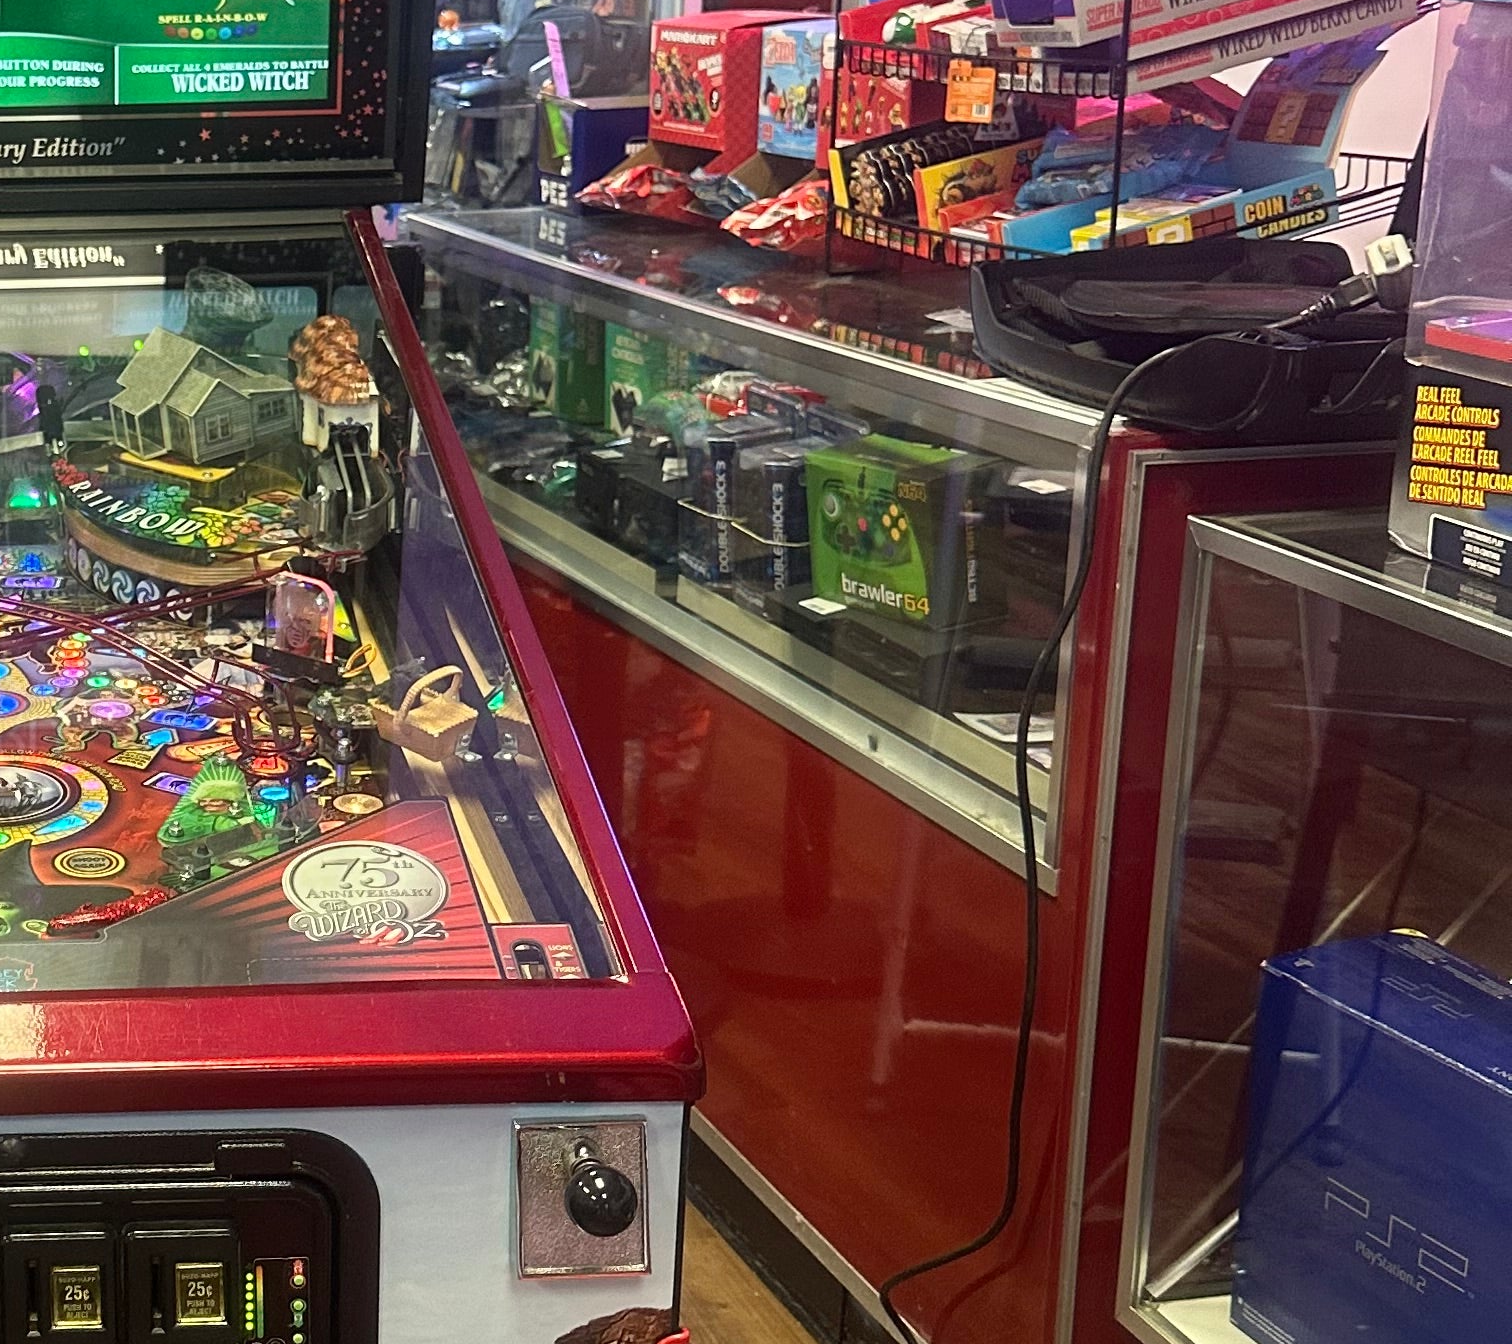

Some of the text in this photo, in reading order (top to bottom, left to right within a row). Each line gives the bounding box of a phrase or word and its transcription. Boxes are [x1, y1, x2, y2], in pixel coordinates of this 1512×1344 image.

[158, 14, 191, 25] SPELL
[52, 61, 104, 73] DURING
[132, 64, 180, 74] COLLECT
[272, 61, 288, 70] TO
[29, 76, 100, 88] PROGRESS
[171, 70, 310, 93] WICKED WITCH
[1245, 195, 1287, 224] COIN
[1416, 386, 1462, 404] REAL FEEL
[1415, 403, 1500, 427] ARCADE CONTROLS
[1413, 425, 1486, 447] COMMANDES DE
[1454, 447, 1476, 466] REEL
[1476, 450, 1500, 468] FEEL
[1410, 465, 1462, 486] CONTROLES
[1462, 470, 1475, 486] DE
[1409, 483, 1486, 507] DE SENTIDO REAL
[68, 479, 206, 536] RAINBOW
[841, 572, 930, 616] brawler64
[320, 856, 415, 889] 75th
[305, 888, 433, 899] ANNIVERSARY
[294, 900, 402, 937] WIZARD
[64, 1285, 90, 1302] 25¢
[188, 1281, 213, 1298] 25¢
